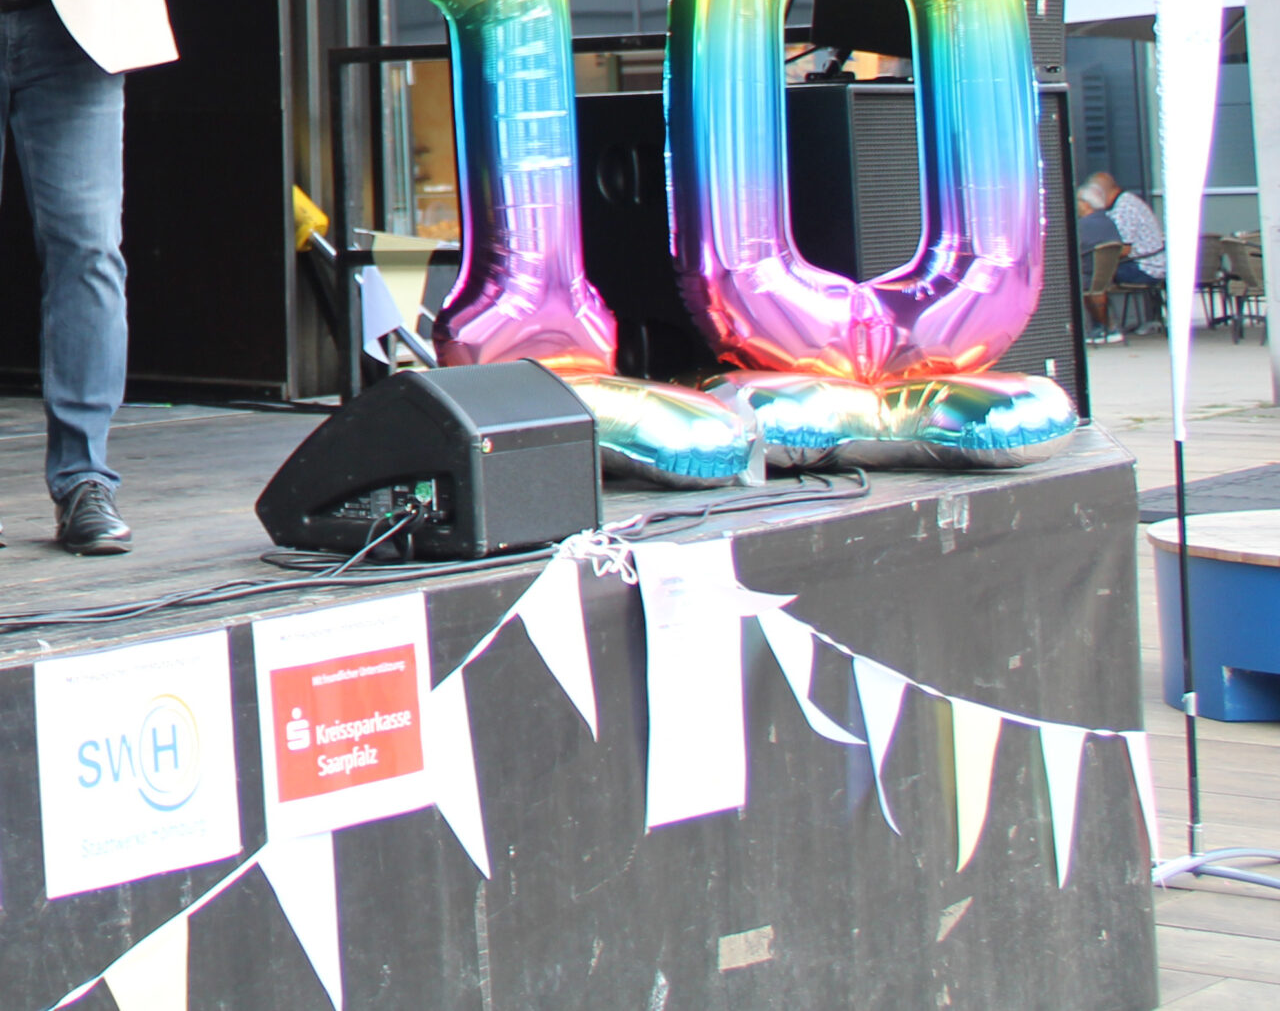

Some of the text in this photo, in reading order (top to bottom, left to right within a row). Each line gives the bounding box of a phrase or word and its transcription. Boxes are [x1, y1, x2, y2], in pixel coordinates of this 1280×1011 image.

[315, 709, 412, 746] Kreissparkasse
[77, 724, 180, 789] SWH
[317, 744, 379, 777] Saarpfalz
